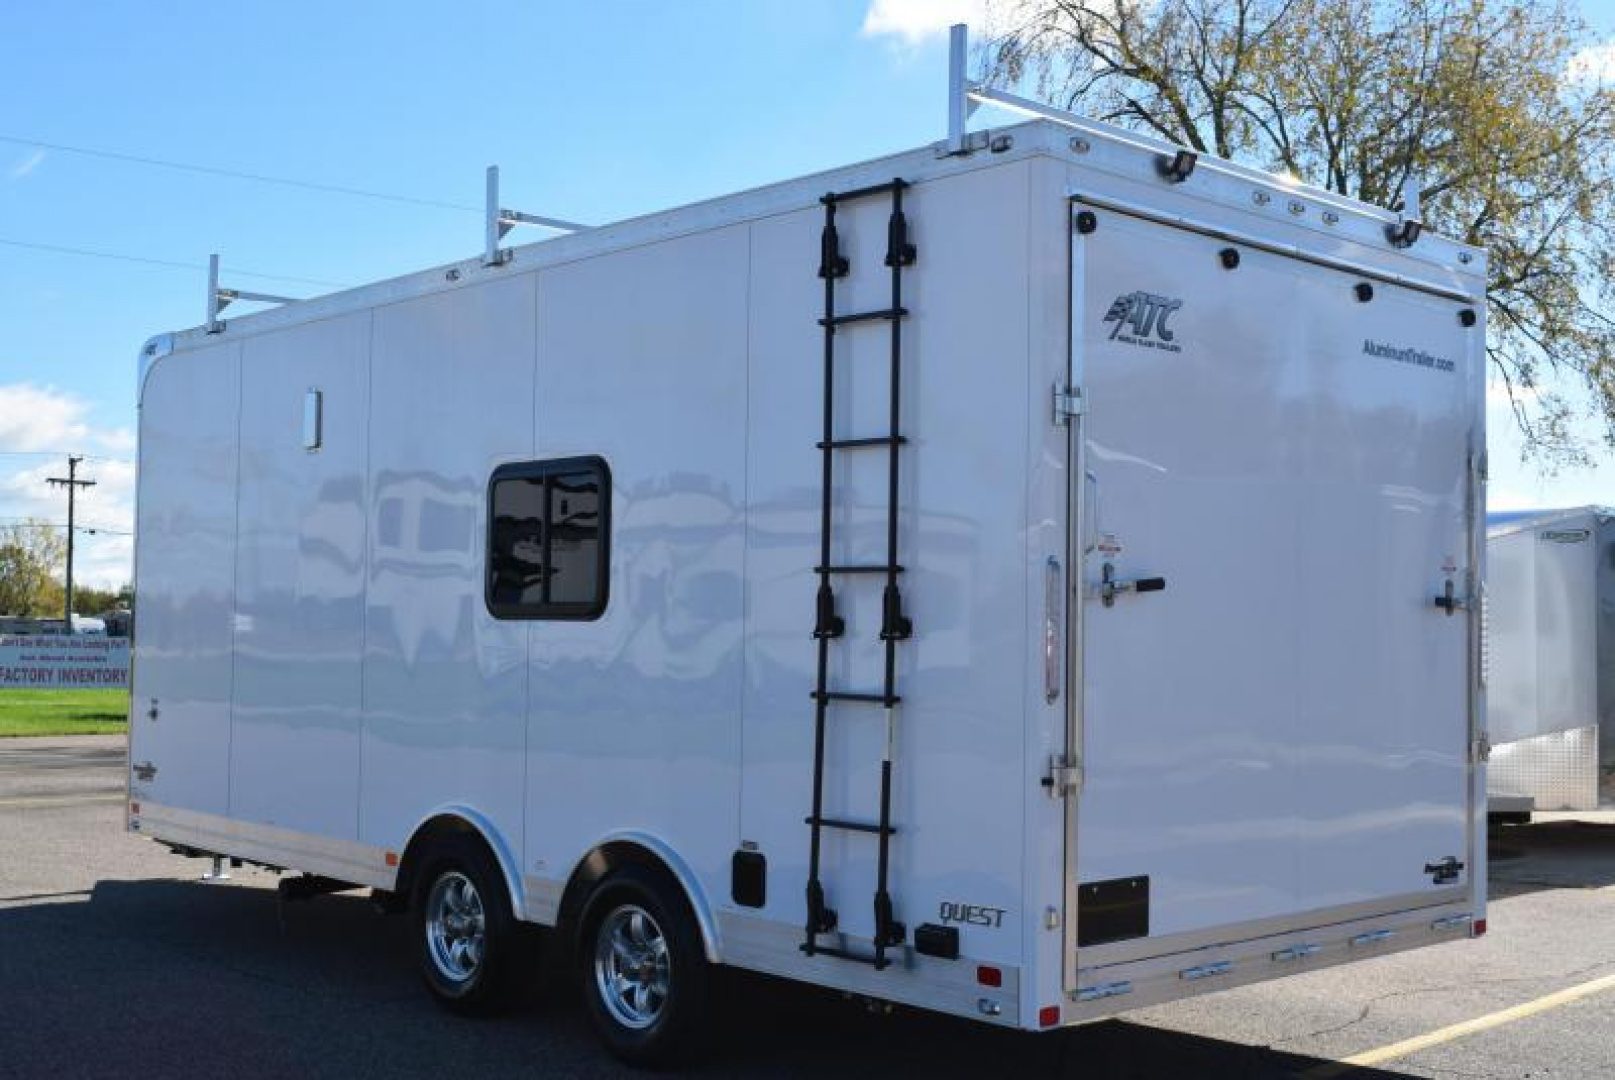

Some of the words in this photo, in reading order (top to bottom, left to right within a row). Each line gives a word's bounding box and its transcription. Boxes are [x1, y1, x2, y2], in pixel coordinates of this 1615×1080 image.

[1104, 290, 1183, 341] ATC
[1362, 339, 1455, 371] AluminumTrailer.com
[58, 667, 128, 683] INVENTORY
[940, 902, 1007, 928] QUEST
